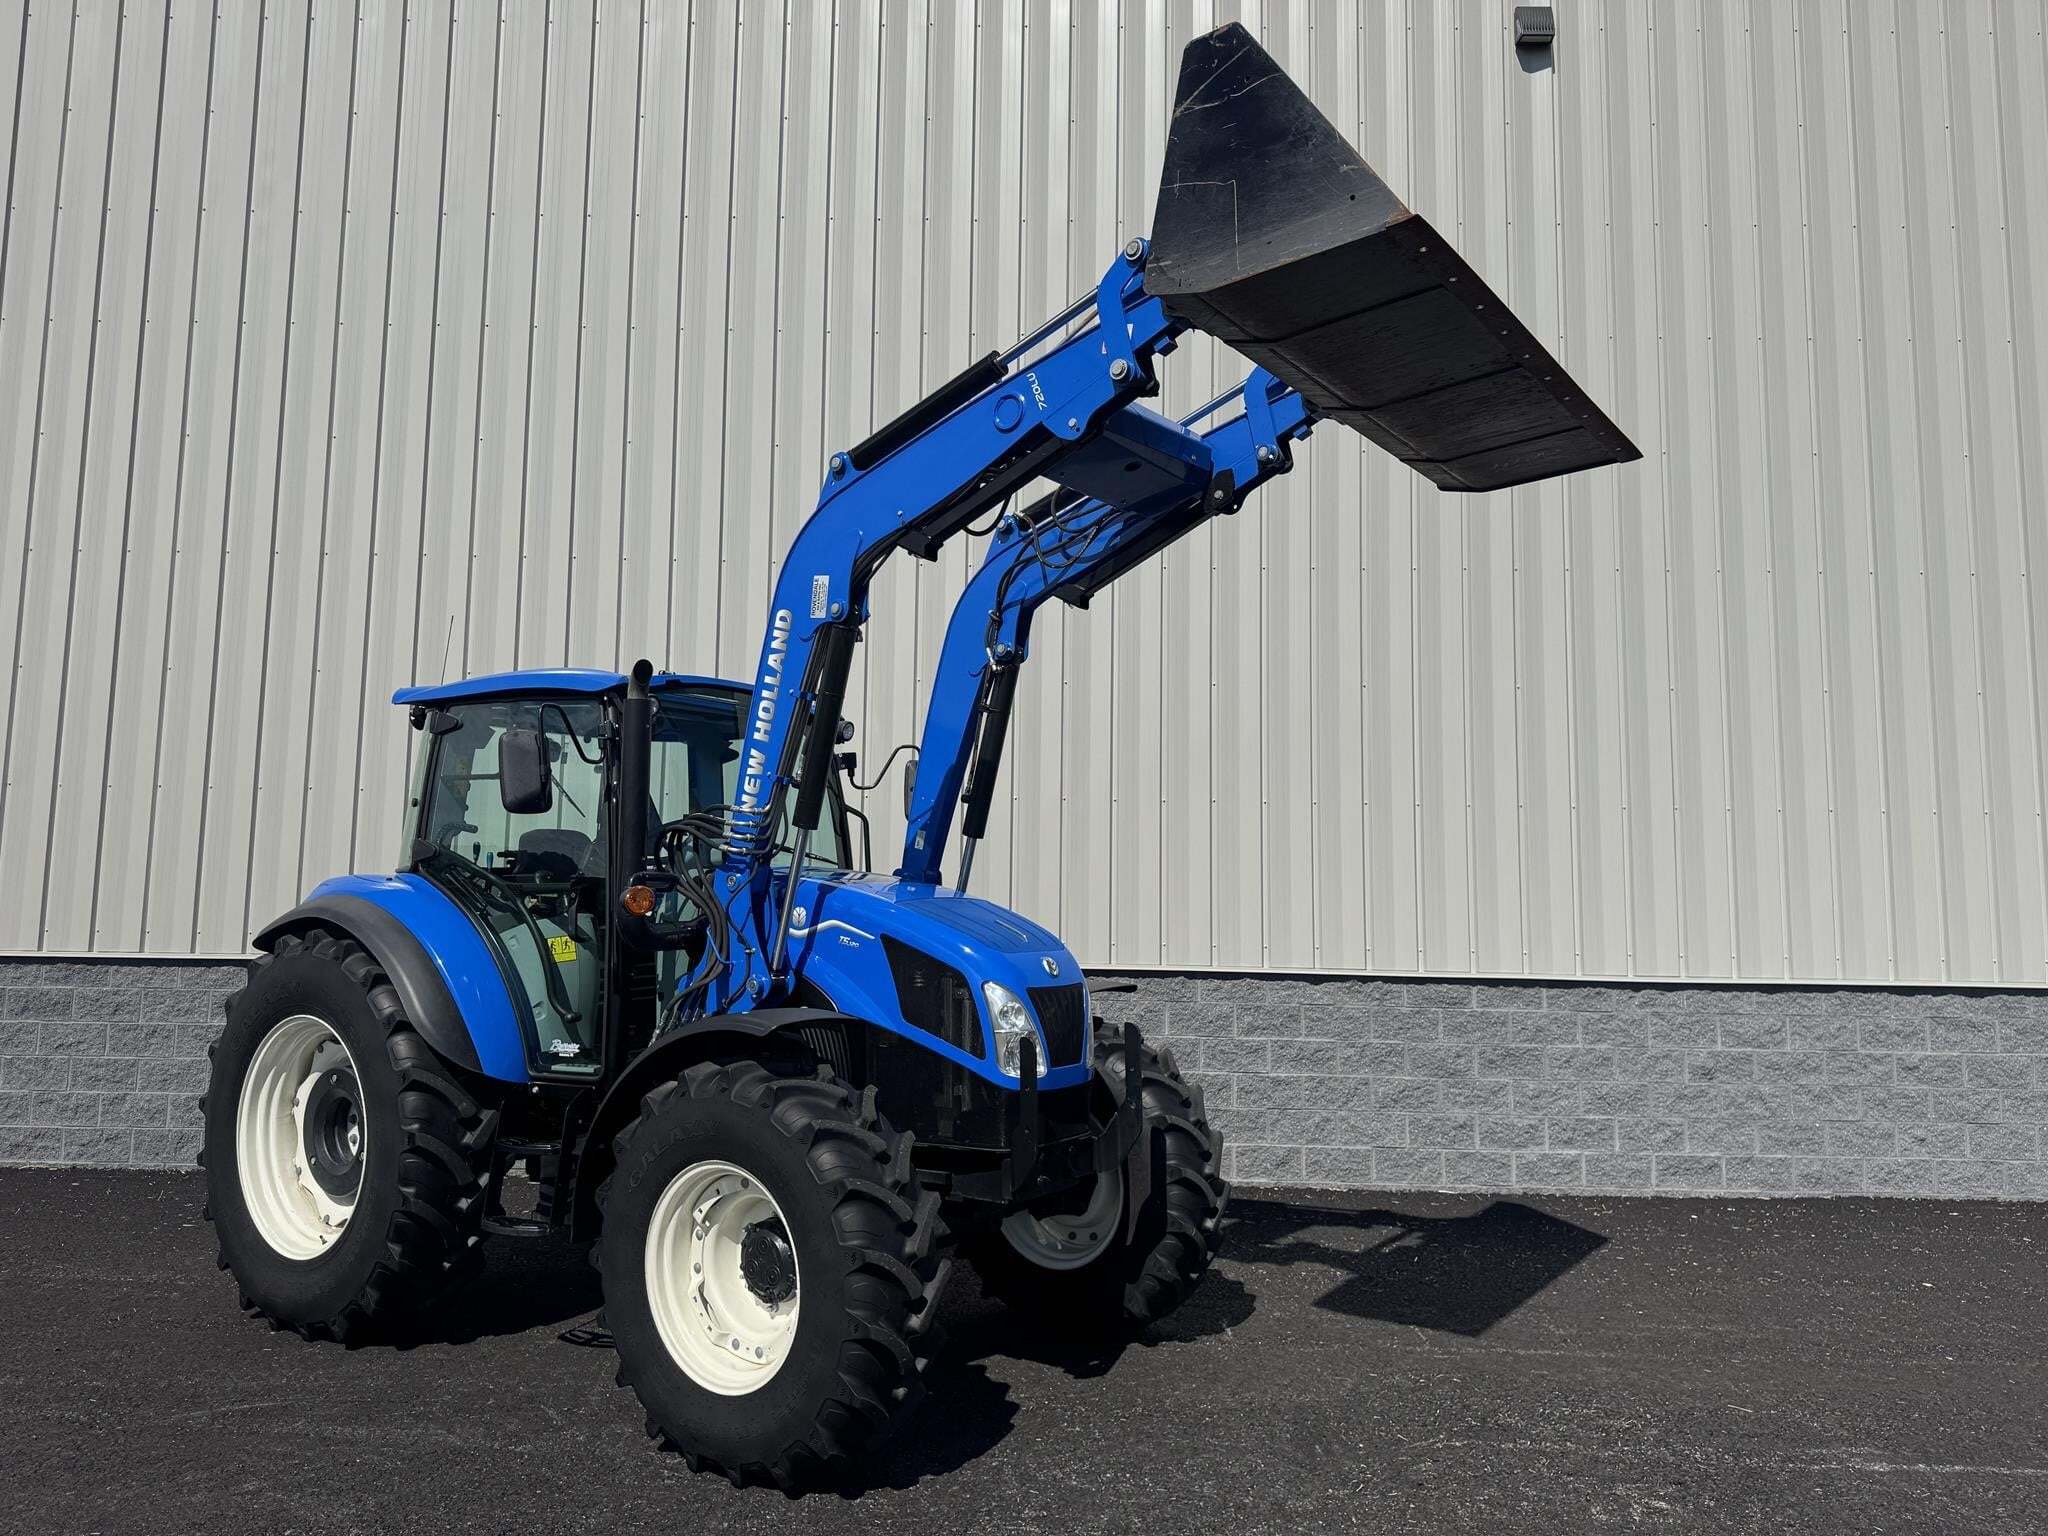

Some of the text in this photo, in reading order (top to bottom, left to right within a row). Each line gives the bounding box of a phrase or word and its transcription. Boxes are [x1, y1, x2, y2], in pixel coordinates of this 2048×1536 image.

[1026, 372, 1047, 410] 720LU
[739, 608, 793, 815] NEW HOLLAND
